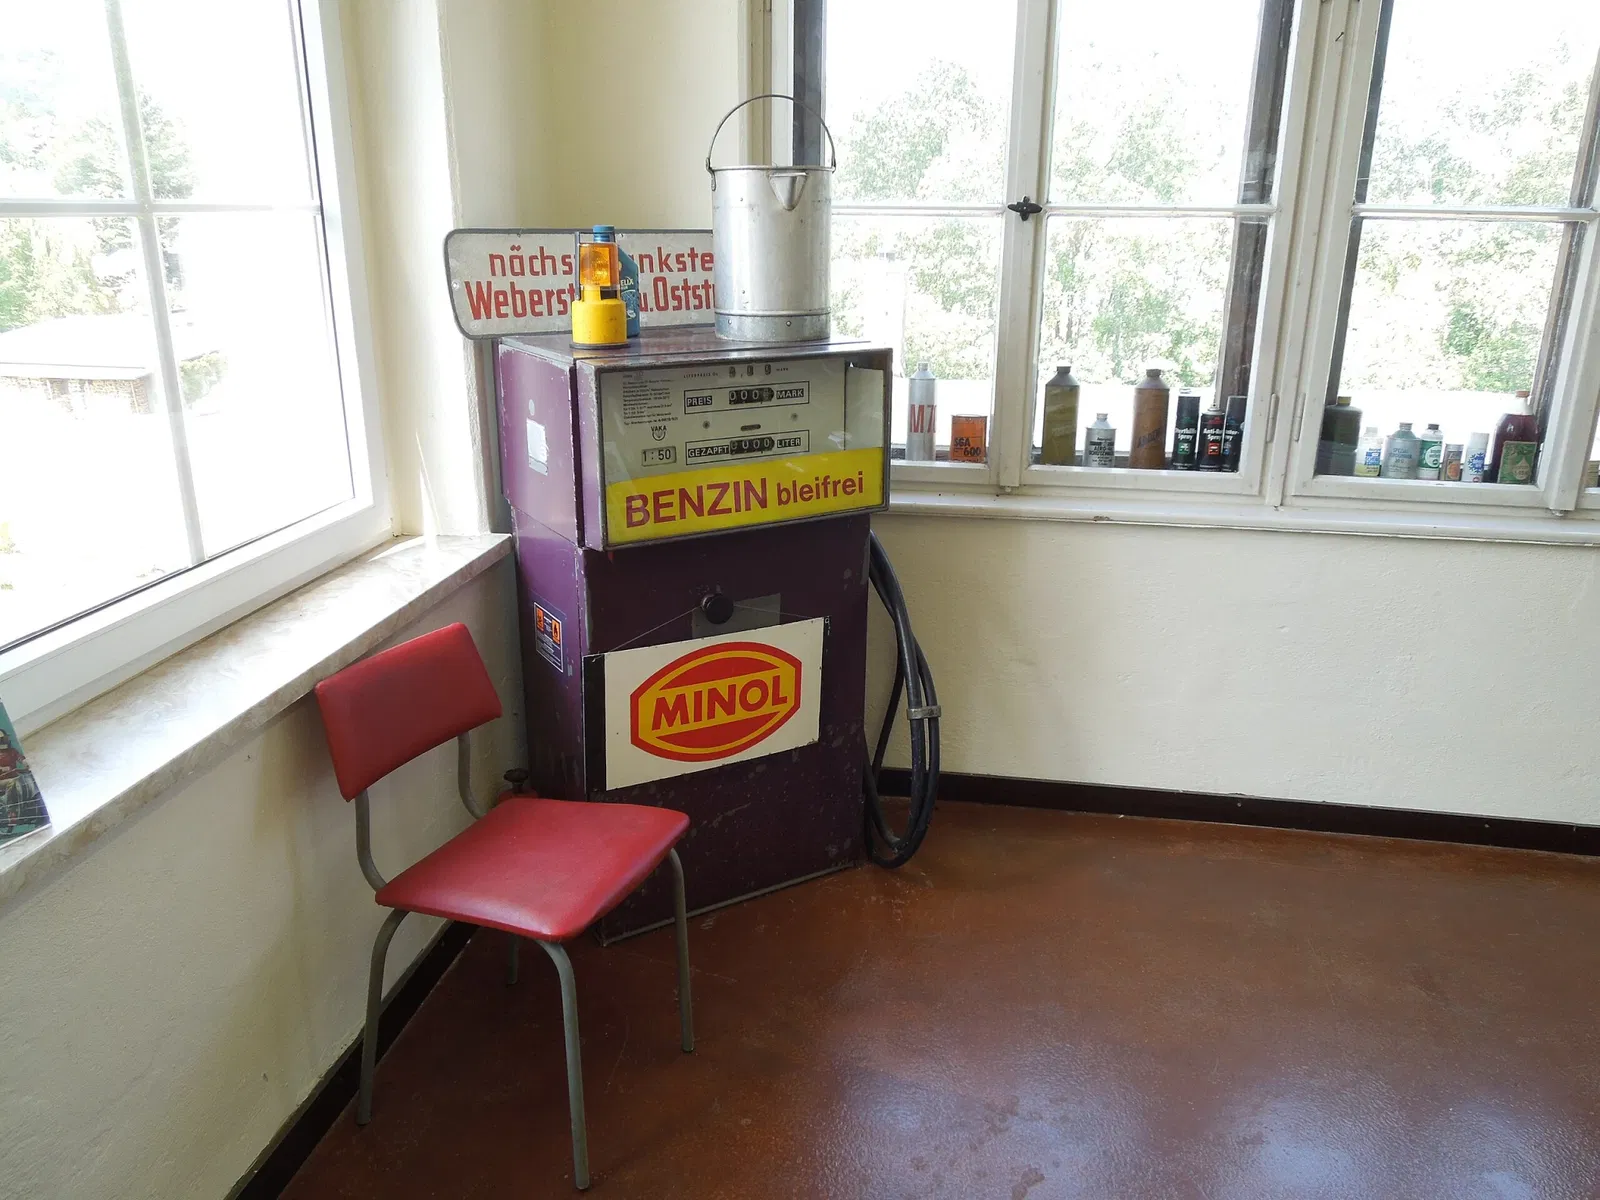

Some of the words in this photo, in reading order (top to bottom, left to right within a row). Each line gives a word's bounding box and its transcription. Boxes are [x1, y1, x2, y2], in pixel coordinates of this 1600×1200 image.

[488, 245, 575, 277] nächs
[632, 247, 714, 274] nkste
[621, 277, 634, 286] ELIX
[464, 280, 575, 320] Weberst
[639, 276, 715, 312] u.Ostst
[687, 396, 712, 407] PREIS
[776, 388, 804, 399] MARK
[688, 445, 729, 458] GEZAPFT
[777, 438, 801, 448] LITER
[625, 477, 768, 529] BENZIN
[776, 470, 864, 506] bleifrei
[651, 674, 788, 731] MINOL
